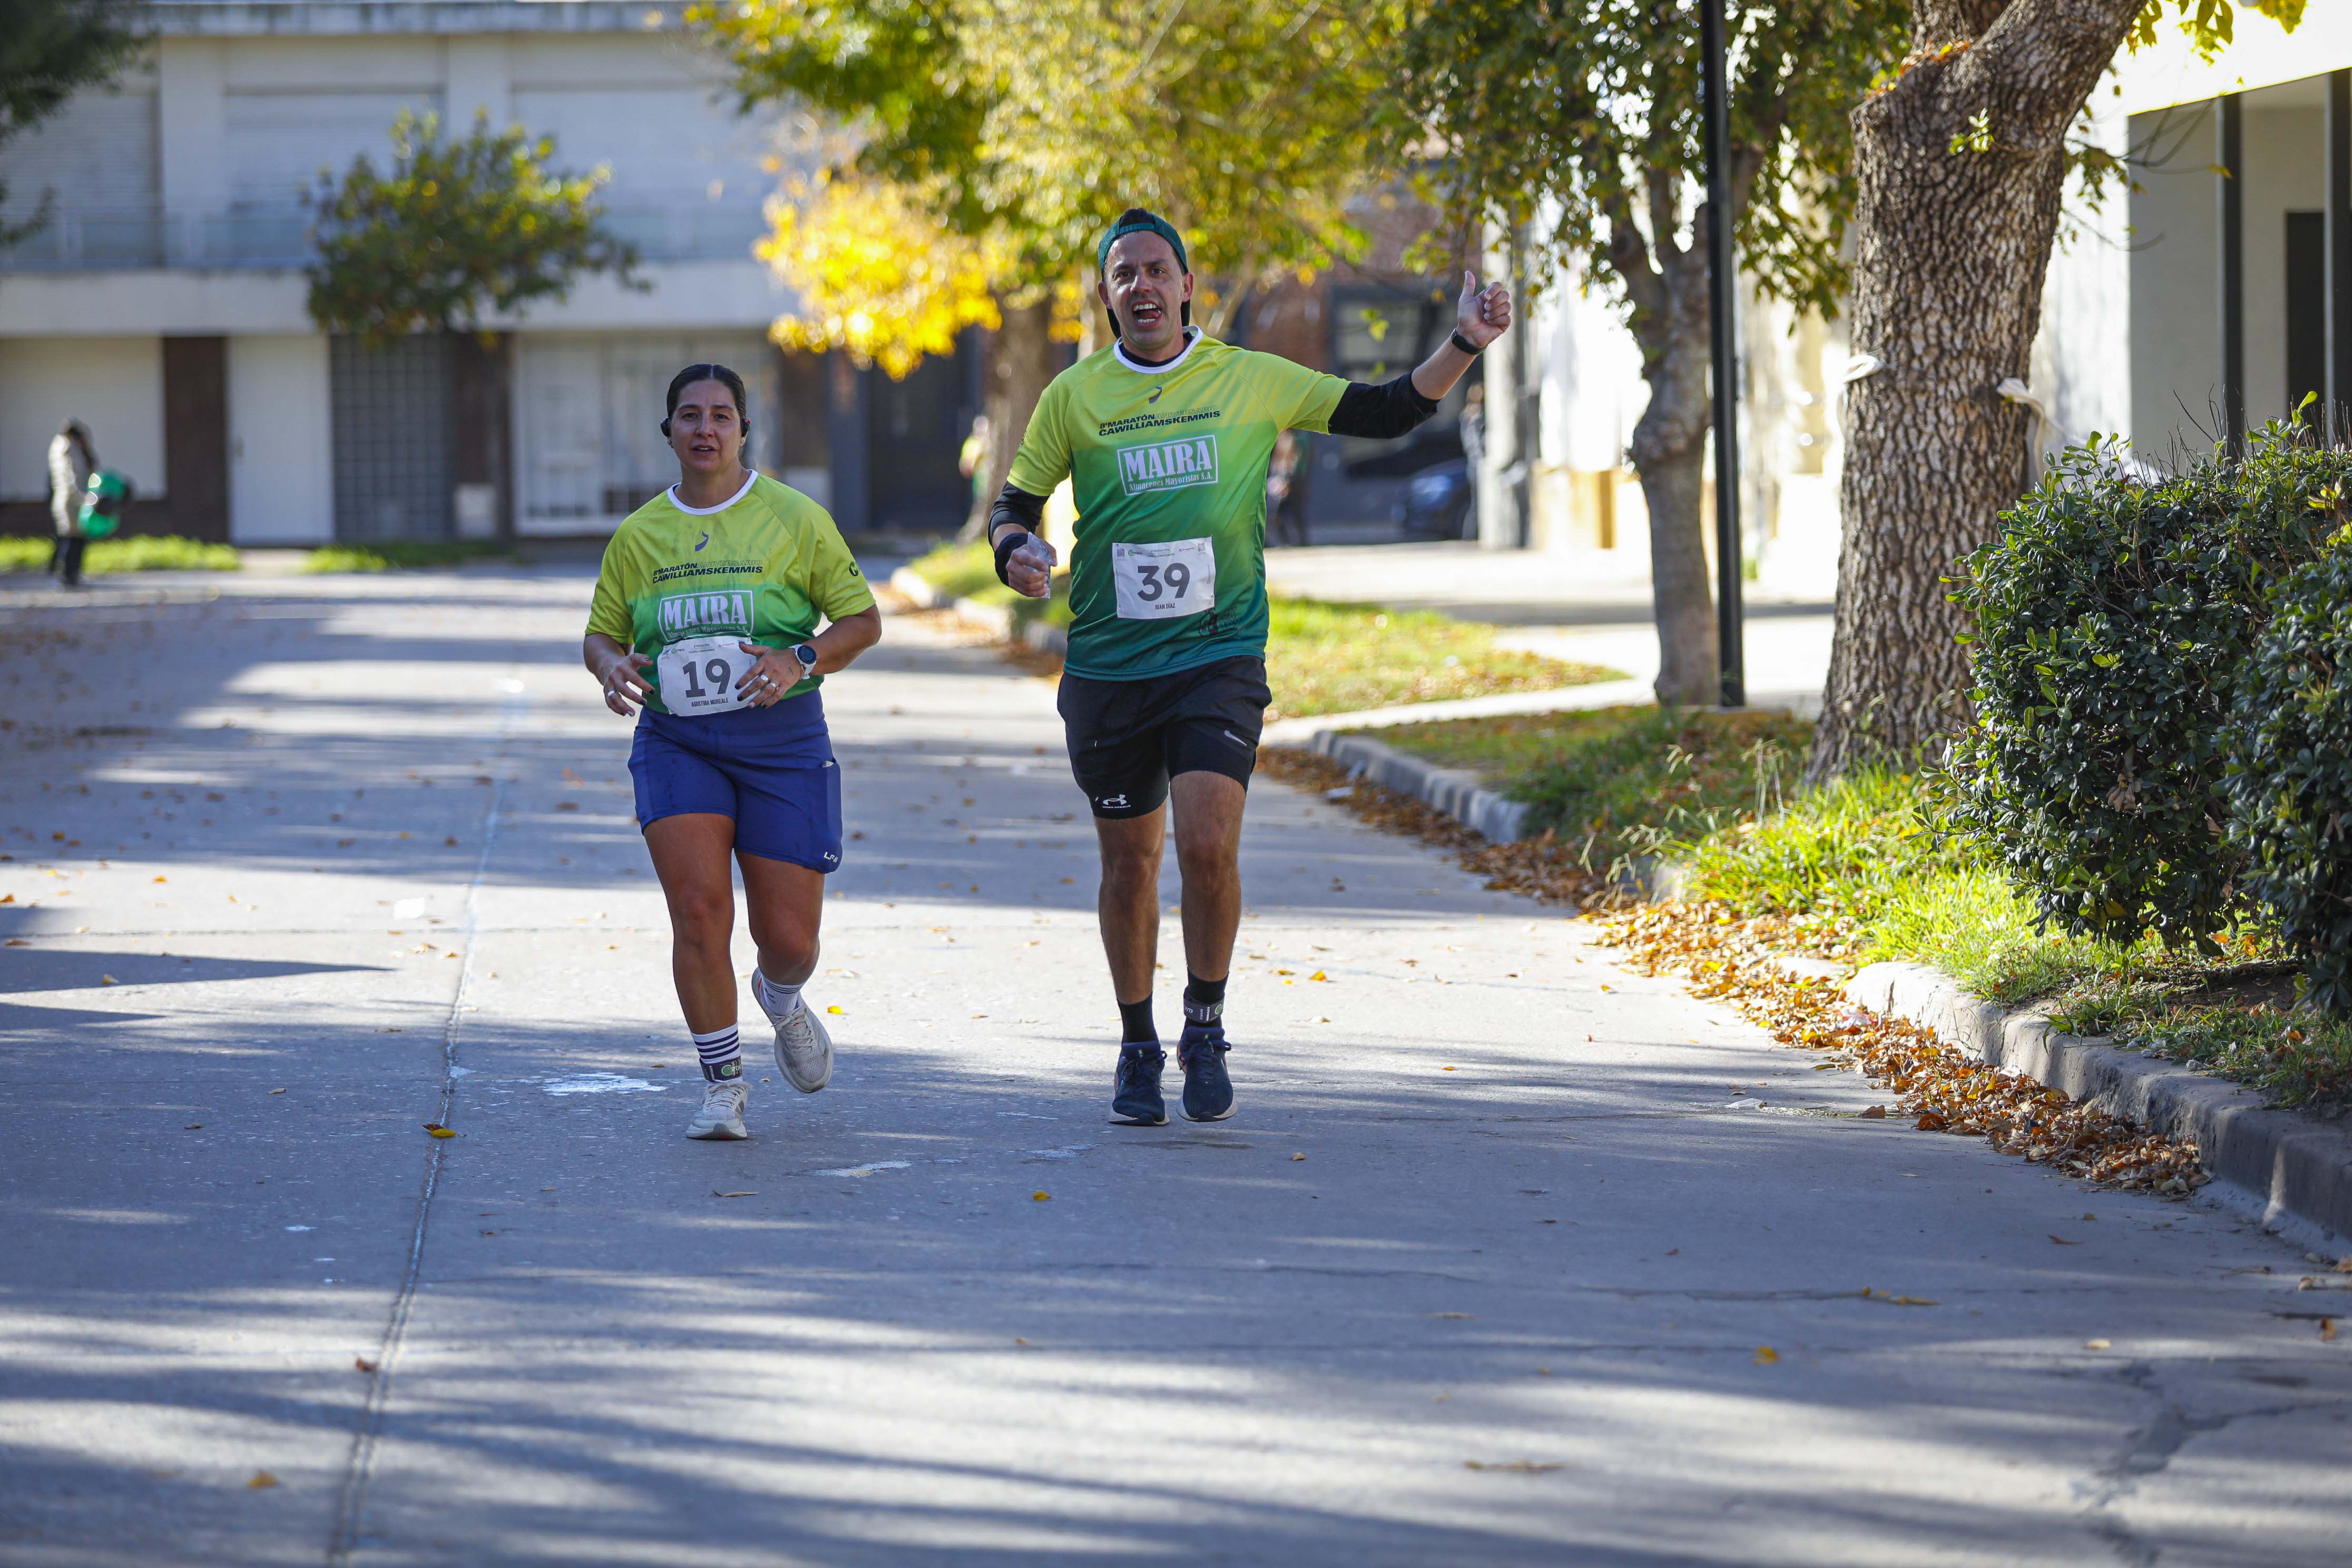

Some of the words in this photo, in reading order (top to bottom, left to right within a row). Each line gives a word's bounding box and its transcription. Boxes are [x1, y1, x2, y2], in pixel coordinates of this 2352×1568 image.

[1123, 440, 1212, 482] MAIRA
[1129, 479, 1163, 492] Almacenes
[1165, 474, 1199, 487] Mayoristas
[1201, 472, 1213, 480] S.A.
[1137, 563, 1190, 601] 39
[664, 594, 747, 631] MAIRA
[682, 658, 731, 698] 19
[710, 697, 729, 705] MOREALE
